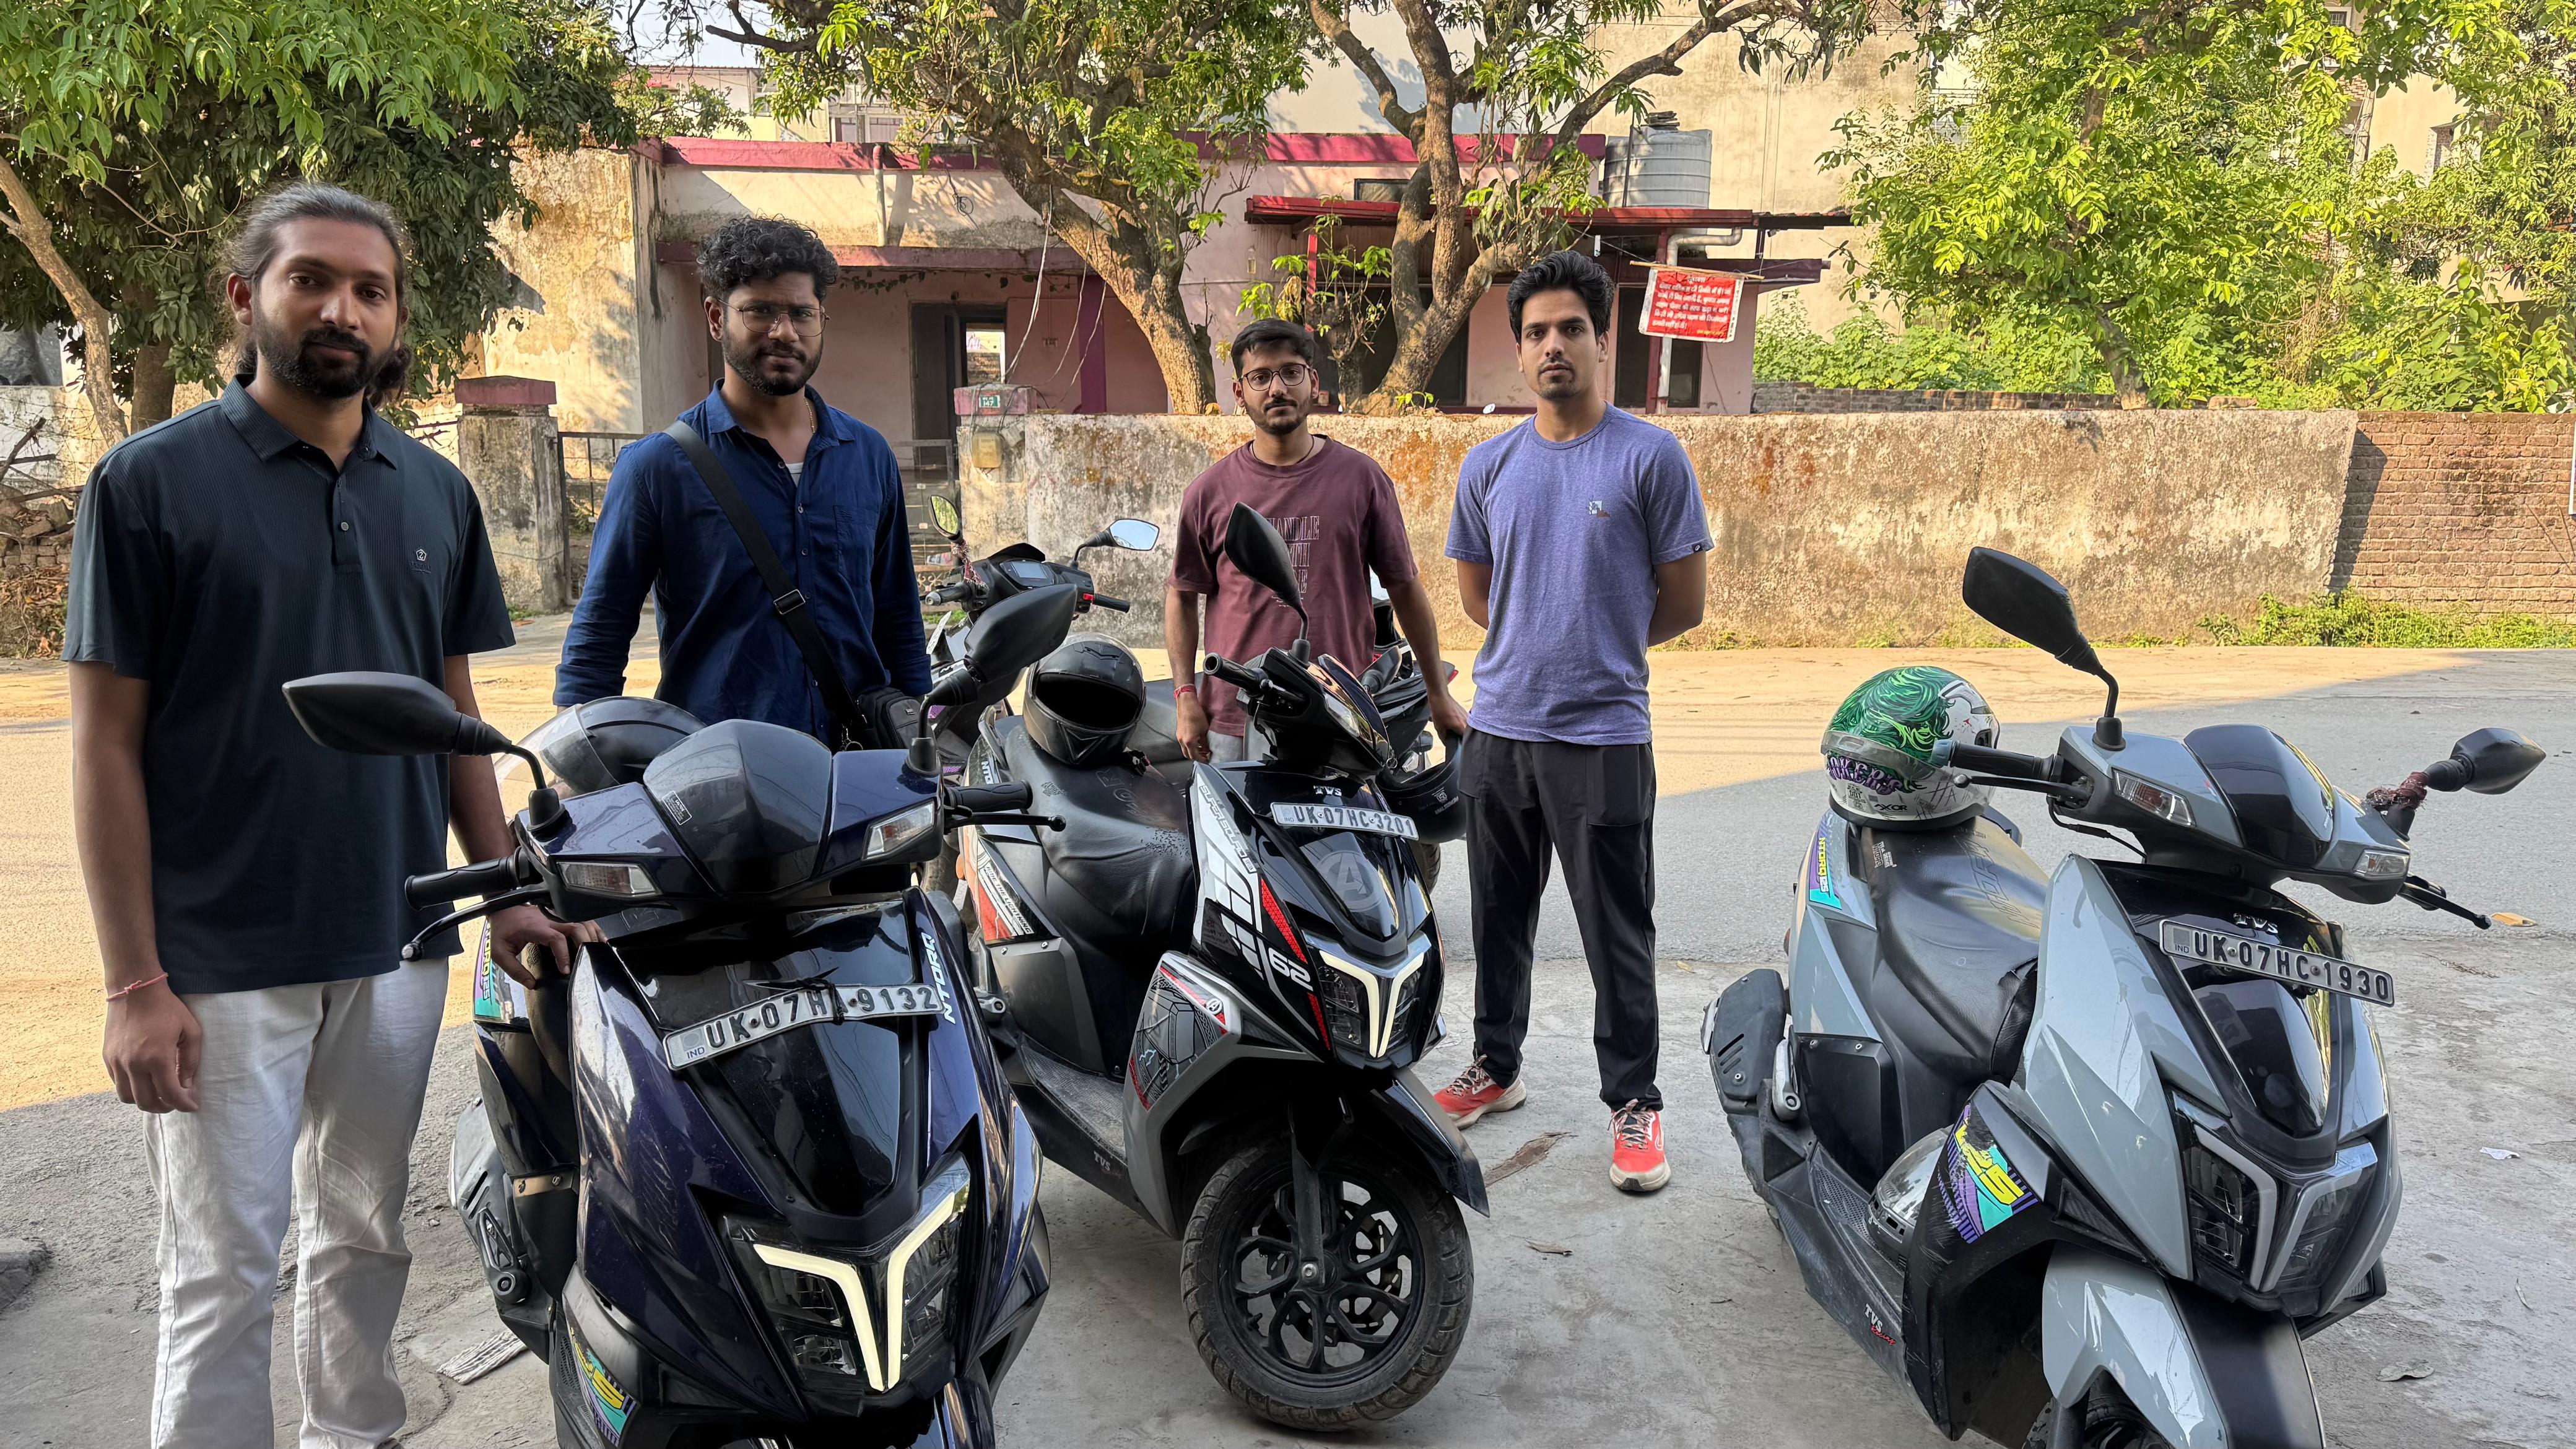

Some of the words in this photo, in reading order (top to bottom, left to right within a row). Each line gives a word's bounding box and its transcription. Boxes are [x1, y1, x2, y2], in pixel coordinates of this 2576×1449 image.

[1266, 516, 1320, 541] ANDLE
[1313, 785, 1342, 797] TVS
[1874, 803, 1907, 812] AXOR
[2175, 944, 2190, 954] IND
[920, 931, 957, 1025] NTORQ
[686, 1046, 705, 1060] IND
[1093, 1151, 1111, 1172] TVS
[1865, 1303, 1883, 1333] TVS
